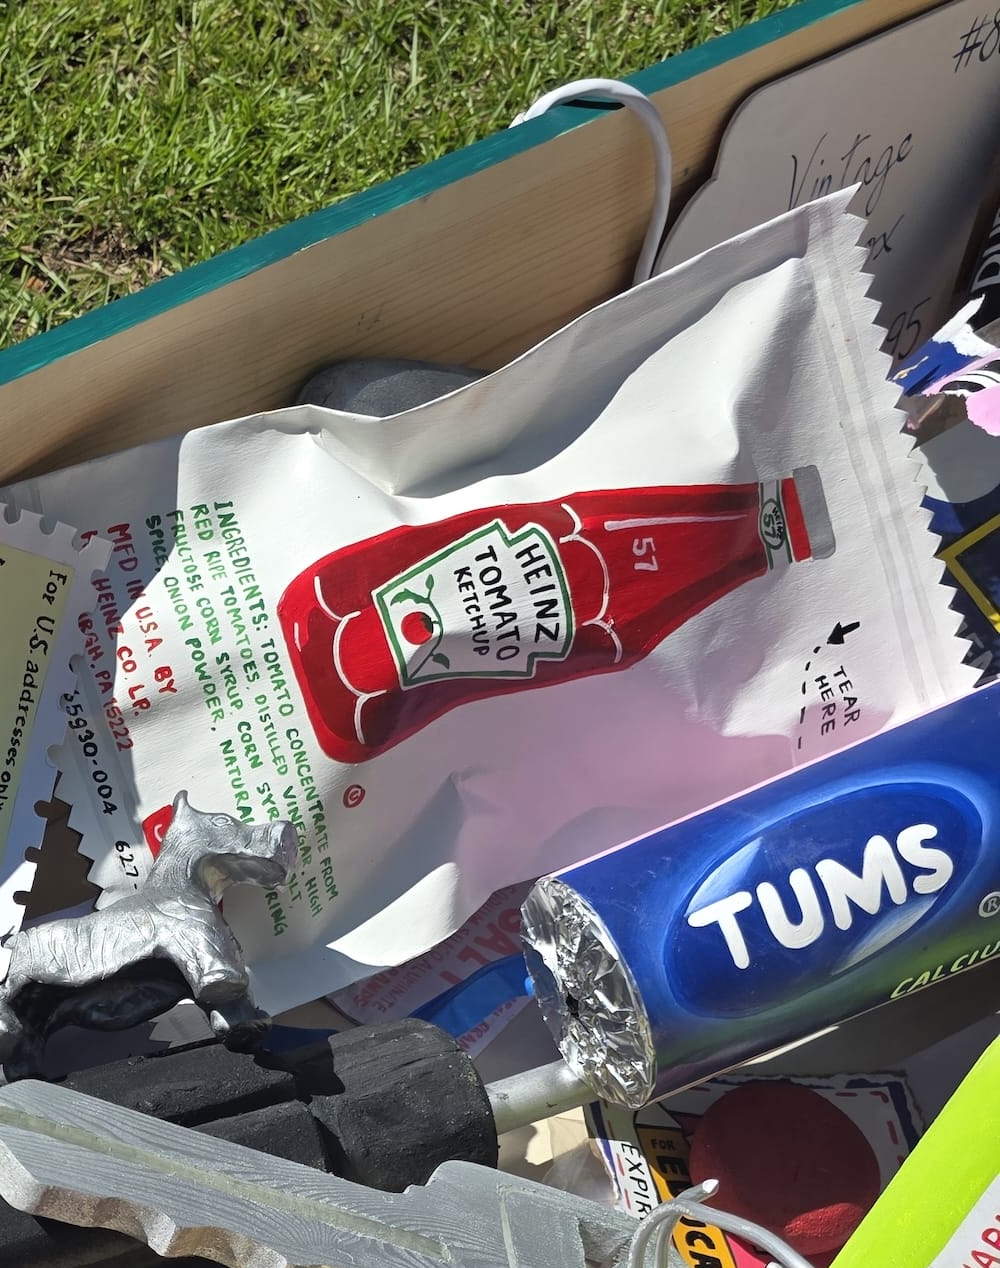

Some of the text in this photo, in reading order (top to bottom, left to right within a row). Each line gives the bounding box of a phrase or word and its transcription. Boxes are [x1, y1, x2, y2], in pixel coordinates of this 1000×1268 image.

[788, 132, 913, 217] Vintage
[42, 569, 68, 607] For
[631, 537, 660, 572] 57
[90, 577, 126, 640] HEINZ
[106, 522, 139, 573] MFD
[125, 579, 147, 601] IN
[153, 665, 178, 694] BY
[163, 576, 195, 633] ONION
[452, 566, 491, 658] KETCHUP
[472, 545, 520, 662] TOMATO
[514, 543, 561, 646] HEINZ
[28, 615, 58, 657] U.S.
[166, 509, 205, 592] FRUCTOSE
[195, 596, 223, 645] CORN
[236, 720, 264, 770] CORN
[4, 659, 40, 769] addresses
[95, 669, 113, 695] PA
[190, 503, 215, 542] RED
[203, 550, 229, 582] RIPE
[254, 693, 289, 777] DISTILLED
[304, 876, 324, 918] HIGH
[213, 500, 340, 901] INGREDIENTS: TOMATO CONCENTRATE FROM
[815, 675, 837, 736] HERE
[832, 664, 862, 727] TEAR
[102, 696, 135, 752] 15222
[686, 822, 955, 970] TUMS
[650, 1138, 678, 1153] FOR
